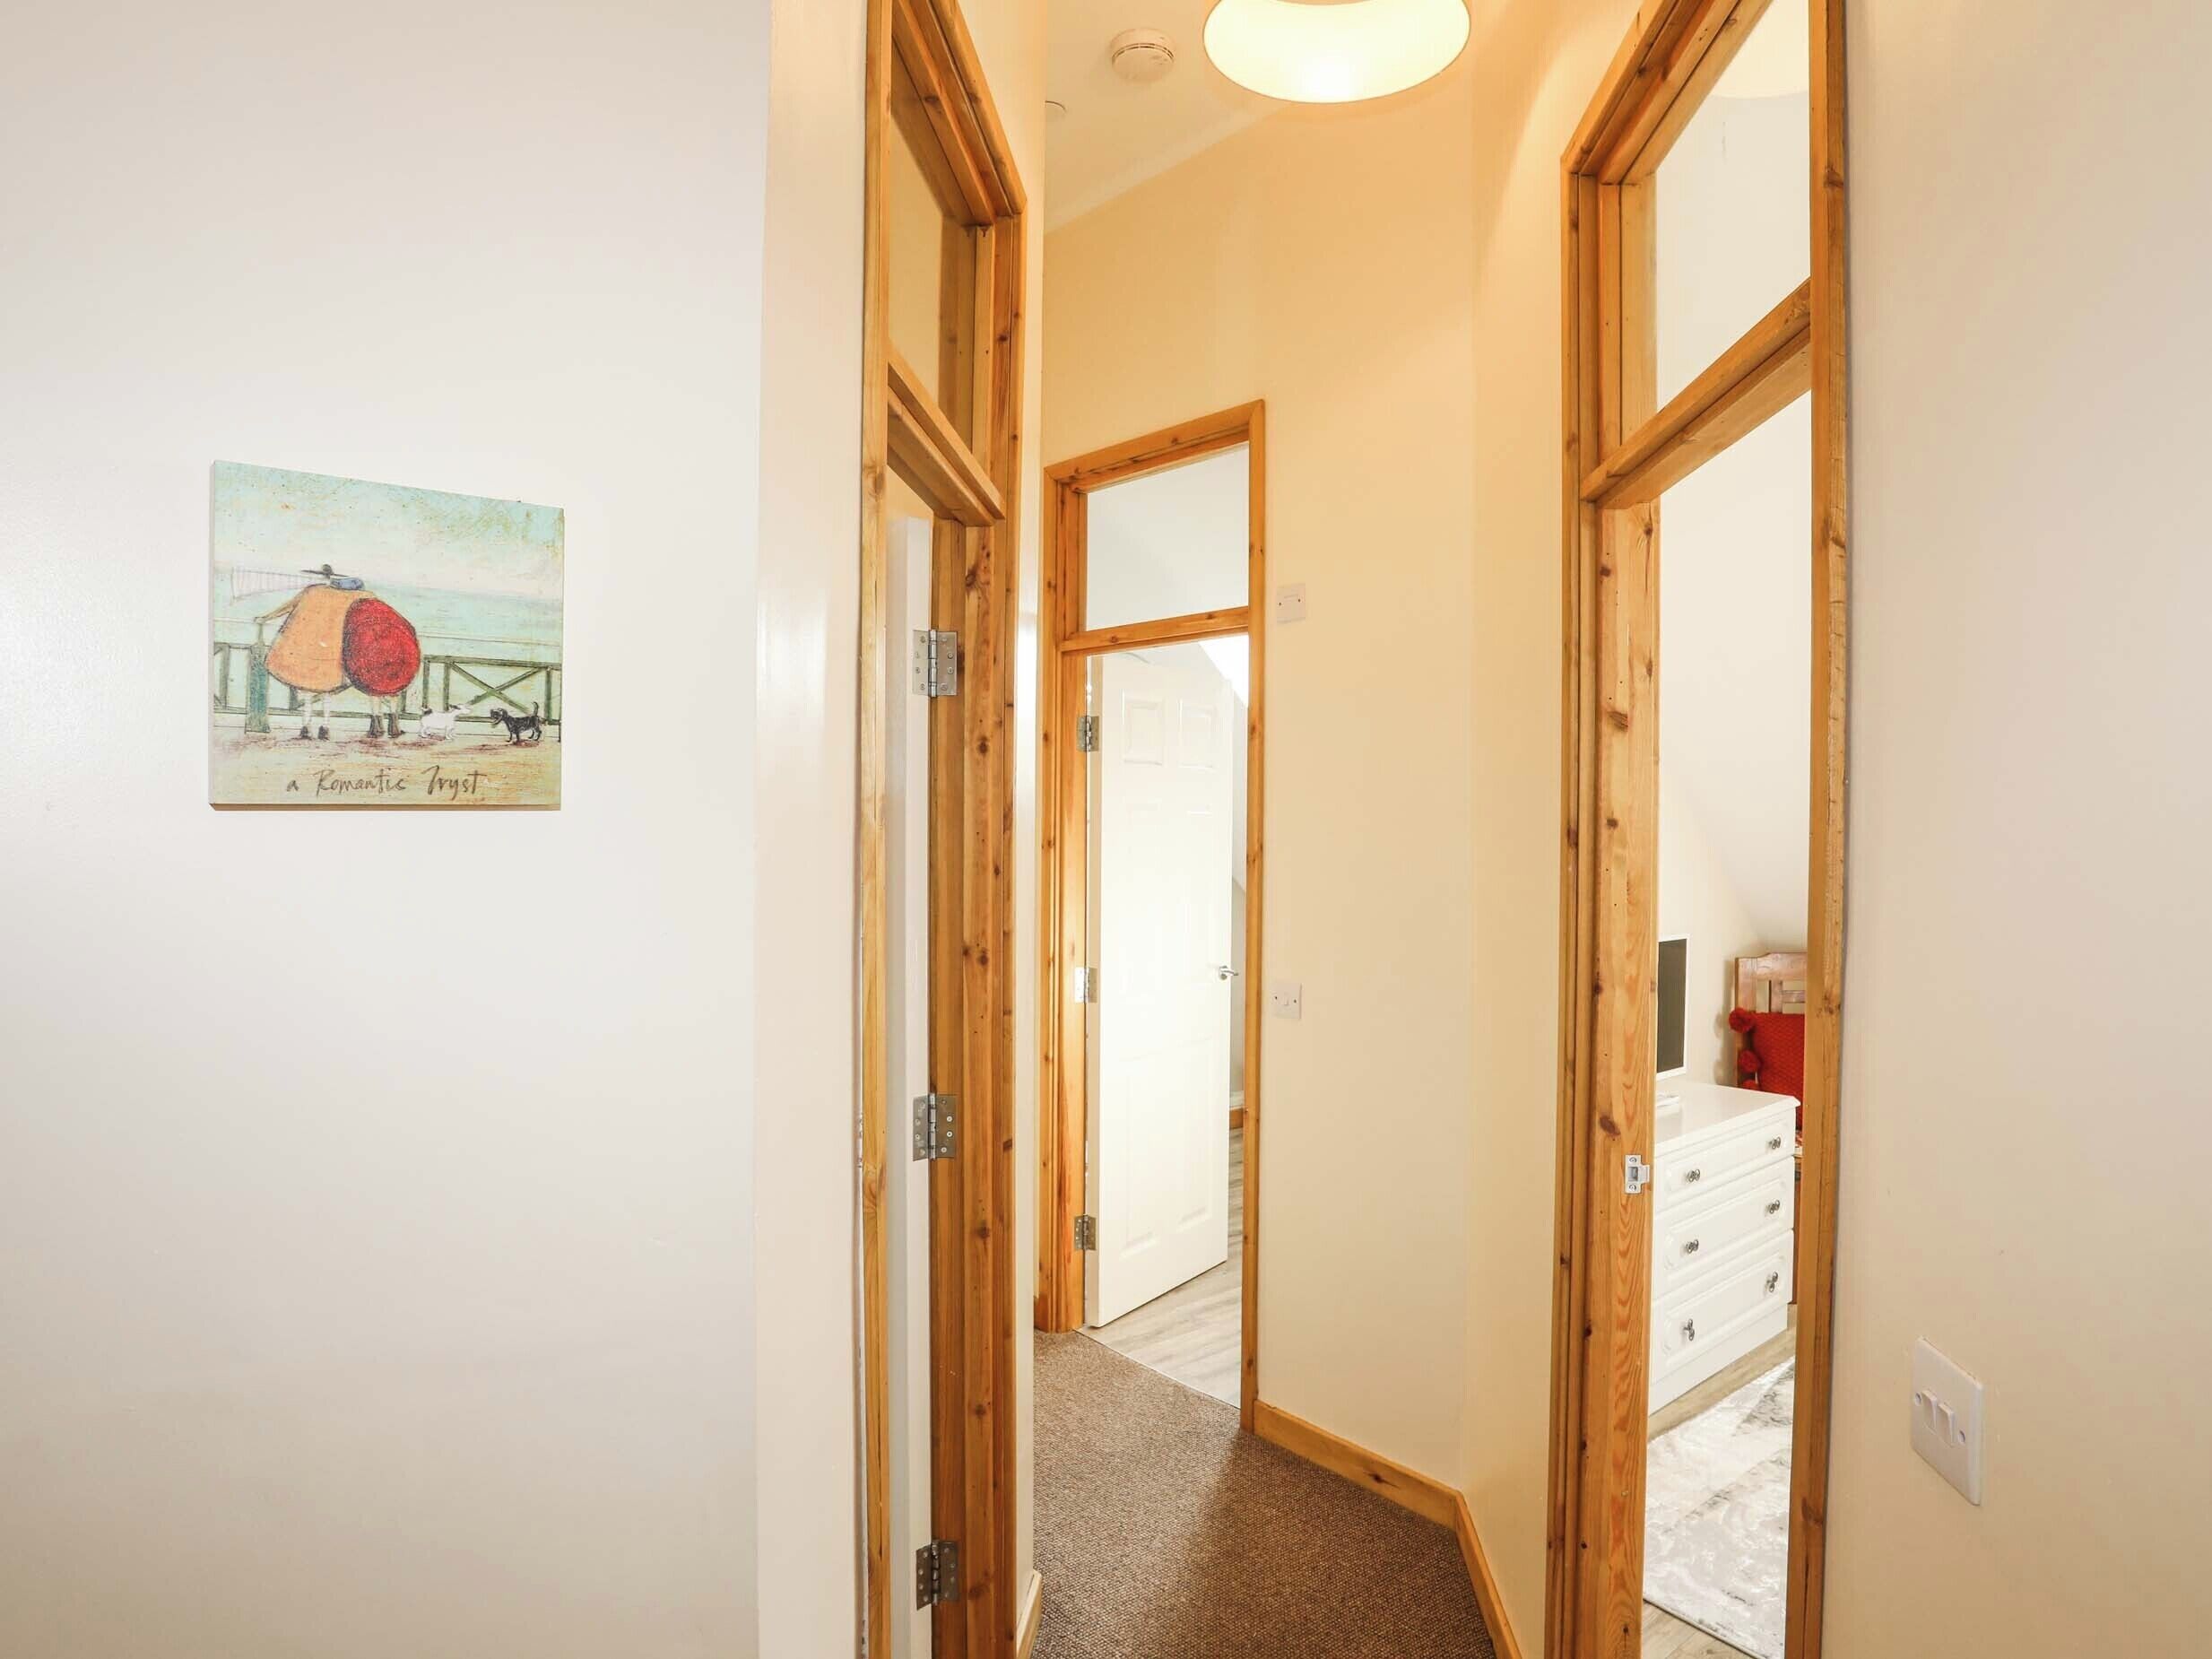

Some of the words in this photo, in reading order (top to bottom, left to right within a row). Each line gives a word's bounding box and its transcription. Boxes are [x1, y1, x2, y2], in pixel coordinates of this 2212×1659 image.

[286, 777, 299, 792] a
[314, 769, 407, 796] Romantic
[421, 765, 487, 800] Tryst
